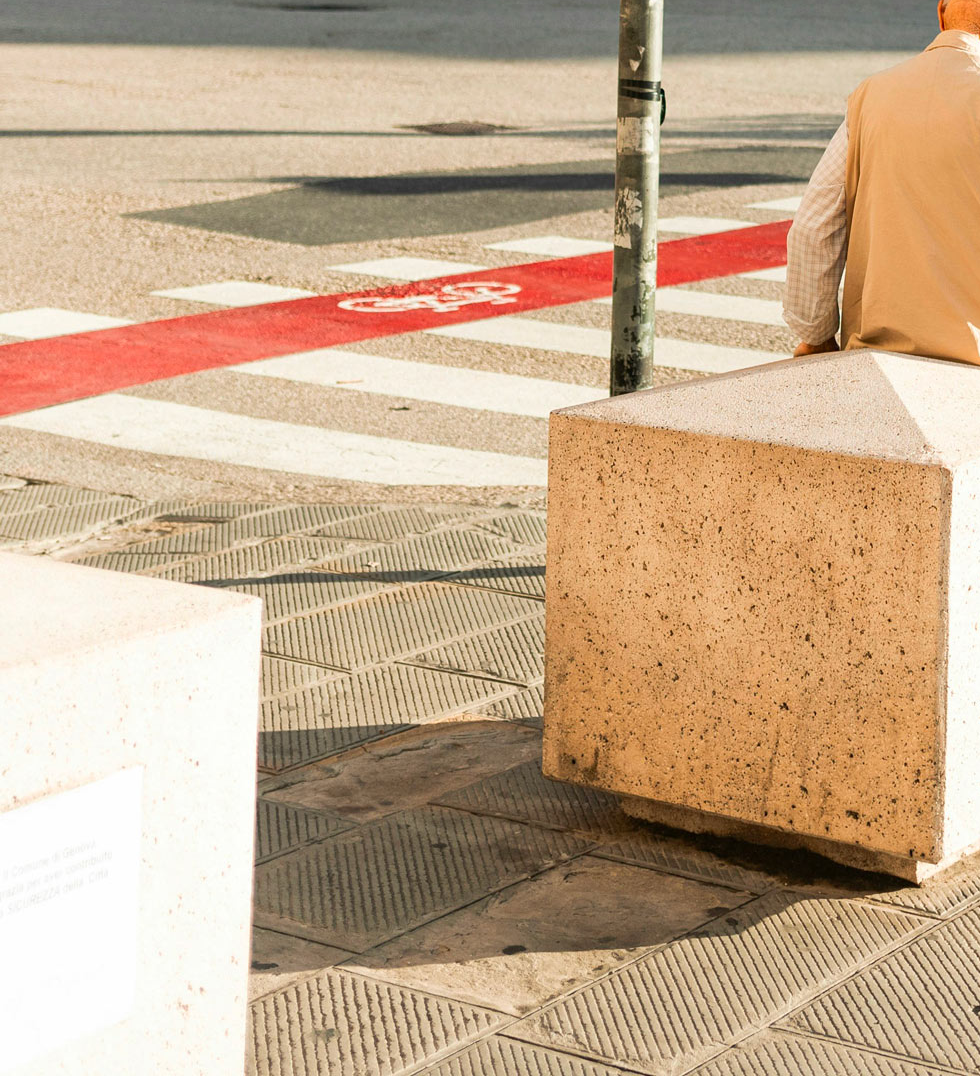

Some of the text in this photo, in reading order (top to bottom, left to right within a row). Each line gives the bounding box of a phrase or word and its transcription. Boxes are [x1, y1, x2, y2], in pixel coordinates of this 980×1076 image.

[11, 858, 50, 879] Comune
[62, 839, 97, 859] Genova
[7, 884, 60, 915] SICUREZZA
